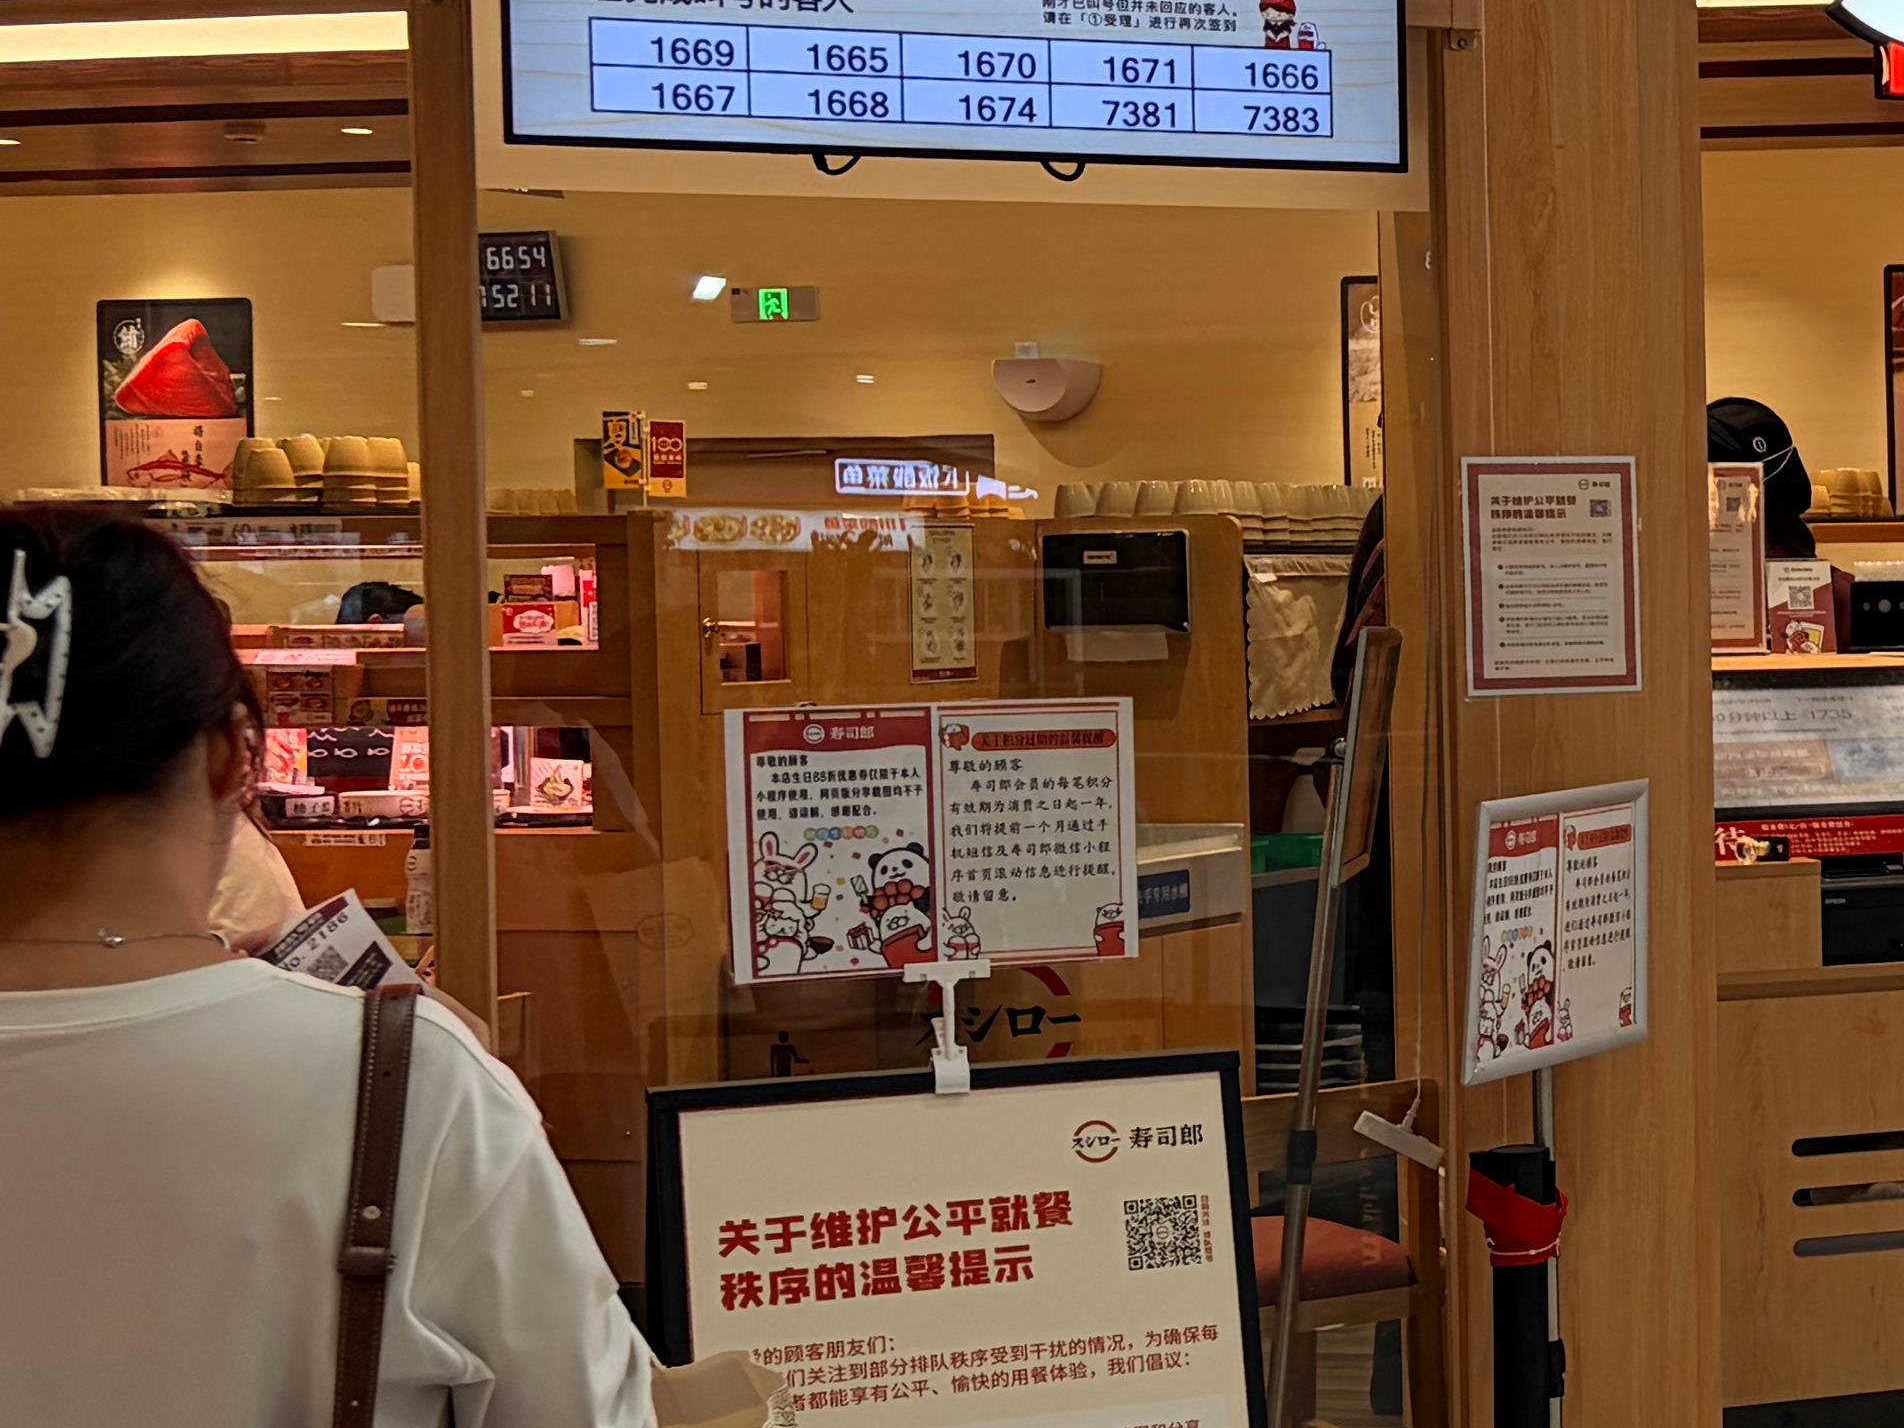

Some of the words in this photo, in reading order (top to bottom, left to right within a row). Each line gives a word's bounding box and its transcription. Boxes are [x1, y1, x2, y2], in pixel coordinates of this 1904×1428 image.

[651, 35, 736, 68] 1669
[806, 42, 889, 74] 1665
[957, 50, 1038, 80] 1670
[1104, 55, 1178, 85] 1671
[1244, 61, 1318, 90] 1666
[651, 81, 736, 113] 1667
[806, 88, 891, 118] 1668
[959, 94, 1038, 124] 1674
[1104, 99, 1179, 129] 7381
[1244, 104, 1320, 133] 7383
[948, 758, 1023, 774] 尊敬的顾客
[1072, 1136, 1121, 1149] スシロー
[1129, 1124, 1203, 1149] 寿司郎
[719, 1191, 1074, 1260] 关于维护公平就餐
[719, 1245, 1034, 1312] 秩序的温馨提示
